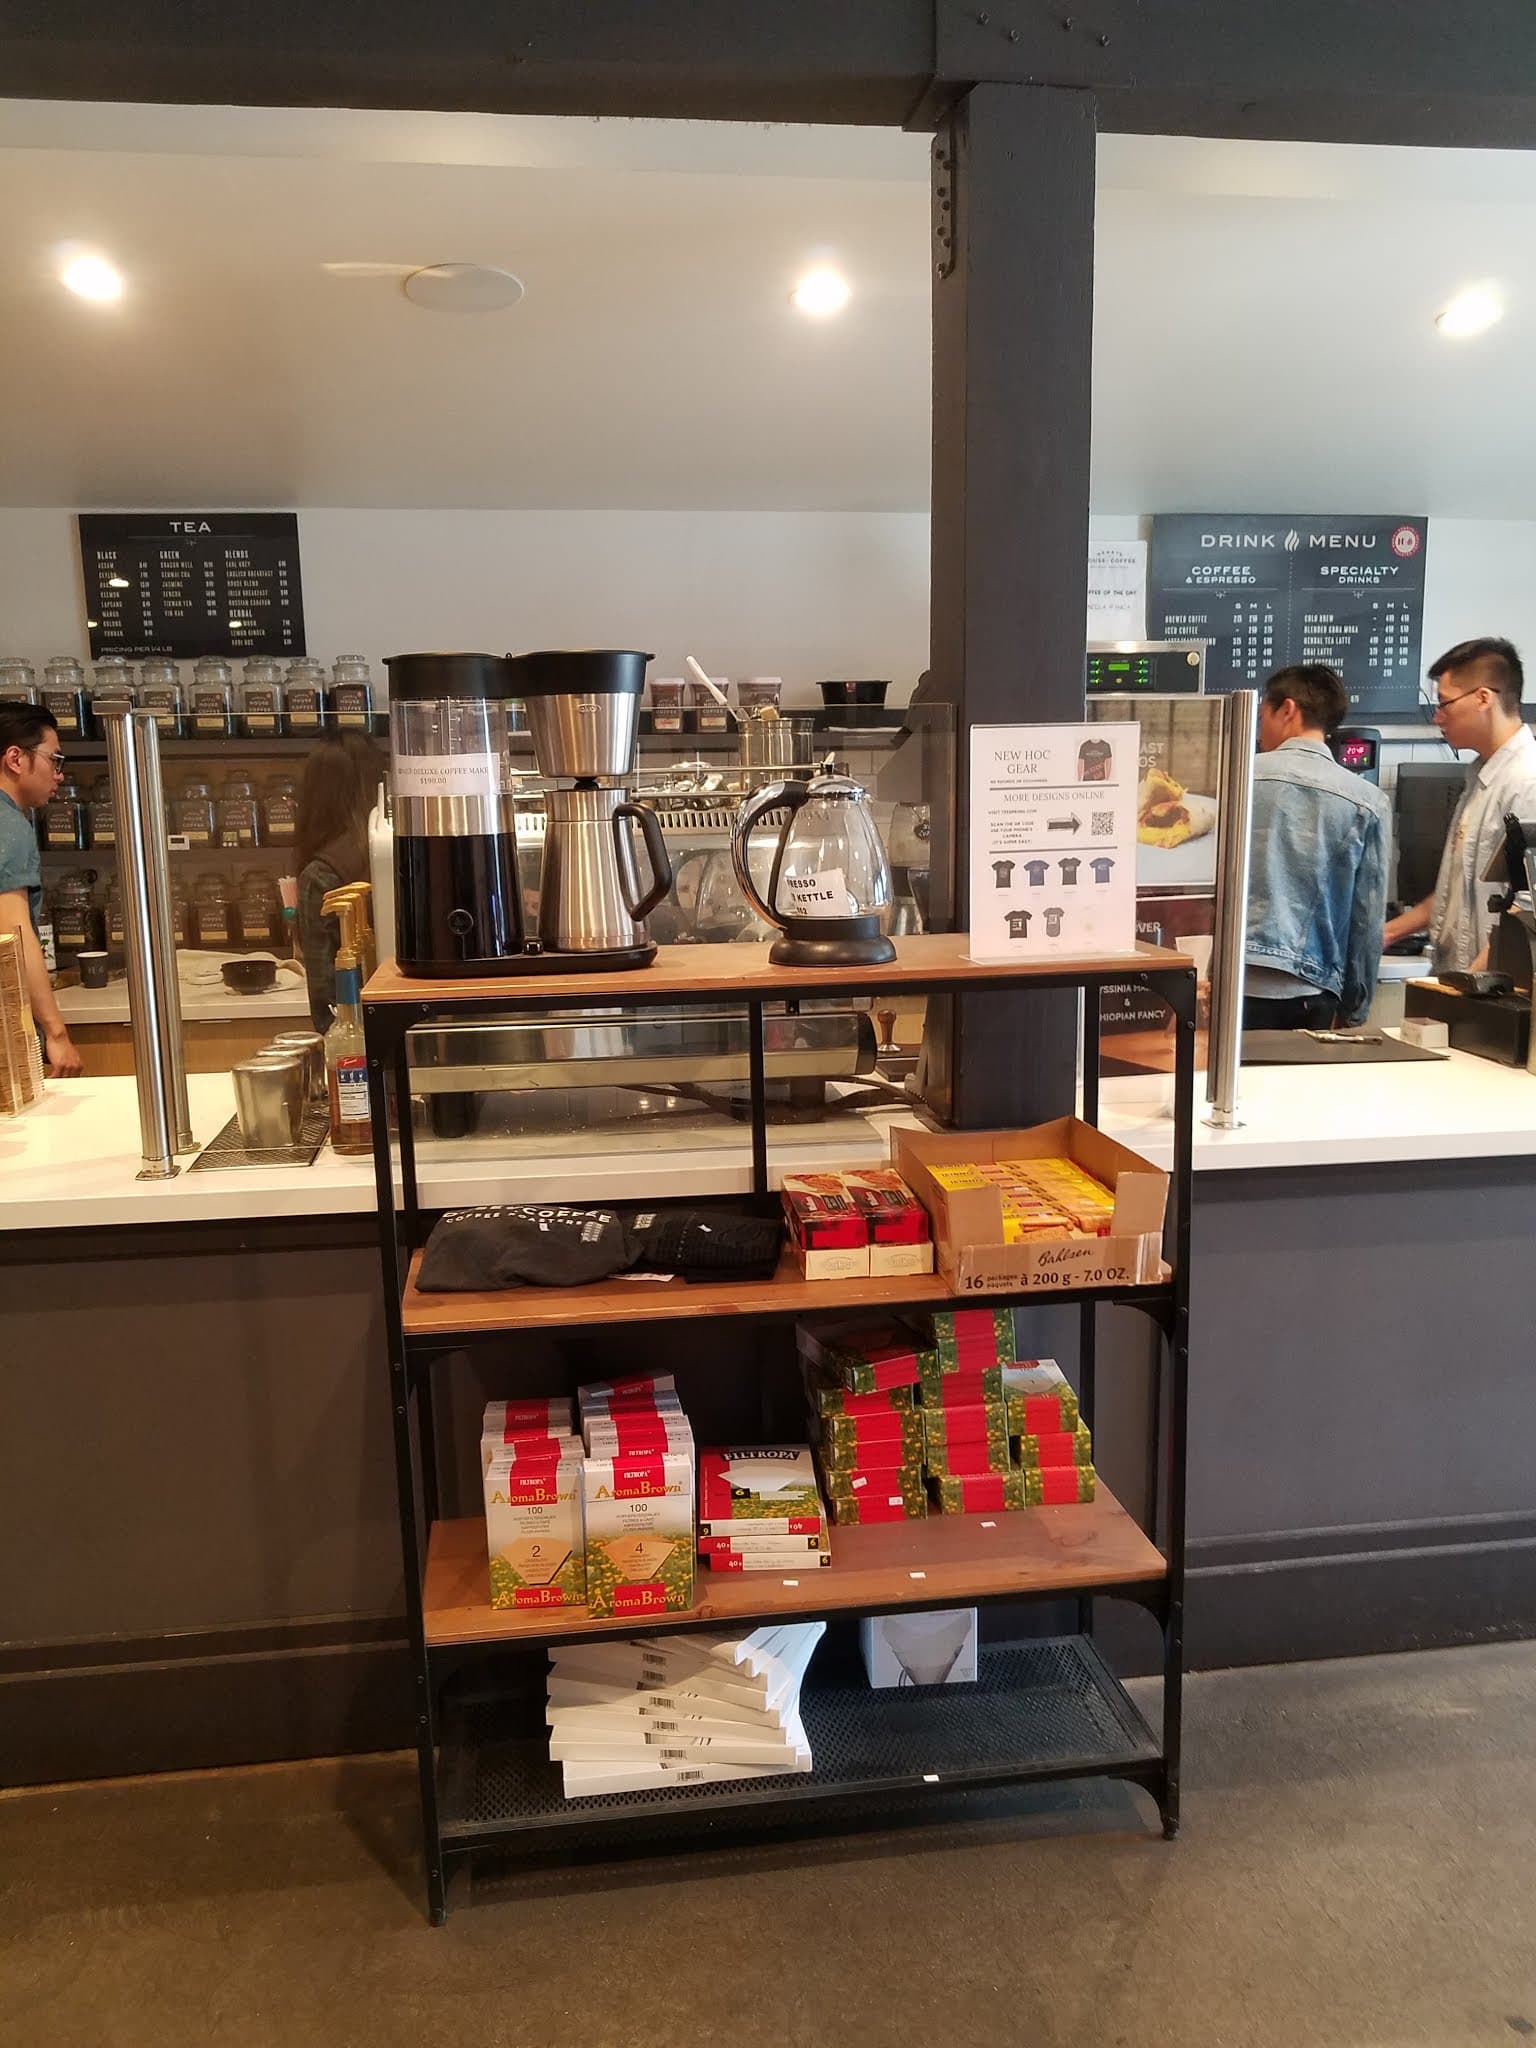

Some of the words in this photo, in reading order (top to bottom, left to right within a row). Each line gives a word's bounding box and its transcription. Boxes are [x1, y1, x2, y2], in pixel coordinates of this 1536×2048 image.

[170, 522, 211, 533] TEA
[1201, 534, 1275, 548] DRINK
[1309, 534, 1376, 548] MENU
[96, 551, 118, 560] BLACK
[159, 550, 180, 559] GREEN
[224, 550, 249, 559] BLENDS
[1191, 566, 1251, 575] COFFEE
[1320, 566, 1399, 575] SPECIALTY
[1196, 576, 1257, 584] ESPRESSO
[1165, 615, 1186, 624] BREWED
[1188, 615, 1207, 623] COFFEE
[1164, 626, 1178, 635] ICED
[1179, 626, 1198, 634] COFFEE
[1335, 636, 1351, 644] LATTE
[1317, 647, 1332, 655] LATTE
[994, 750, 1022, 761] NEW
[1007, 763, 1038, 774] GEAR
[1003, 793, 1030, 802] MORE
[1032, 792, 1070, 801] DESIGNS
[1071, 791, 1105, 800] ONLINE
[798, 890, 834, 903] KETTLE
[1136, 922, 1161, 933] VER
[1124, 998, 1130, 1006] &
[1138, 1010, 1166, 1019] FANCY
[1038, 1247, 1095, 1267] Bahlsen
[965, 1274, 985, 1290] 16
[987, 1273, 1018, 1282] packages
[1020, 1274, 1028, 1286] à
[1033, 1272, 1059, 1286] 200
[1063, 1273, 1071, 1286] g
[1083, 1269, 1102, 1282] 7.0
[723, 1450, 796, 1461] FILTROPA
[595, 1481, 681, 1498] AromaBrown
[490, 1488, 576, 1504] AromaBrown
[527, 1507, 543, 1515] 100
[630, 1504, 648, 1512] 100
[532, 1545, 541, 1558] 2
[635, 1543, 643, 1554] 4
[822, 1556, 828, 1564] 6
[496, 1590, 582, 1604] AromaBrown
[592, 1591, 685, 1609] AromaBrown
